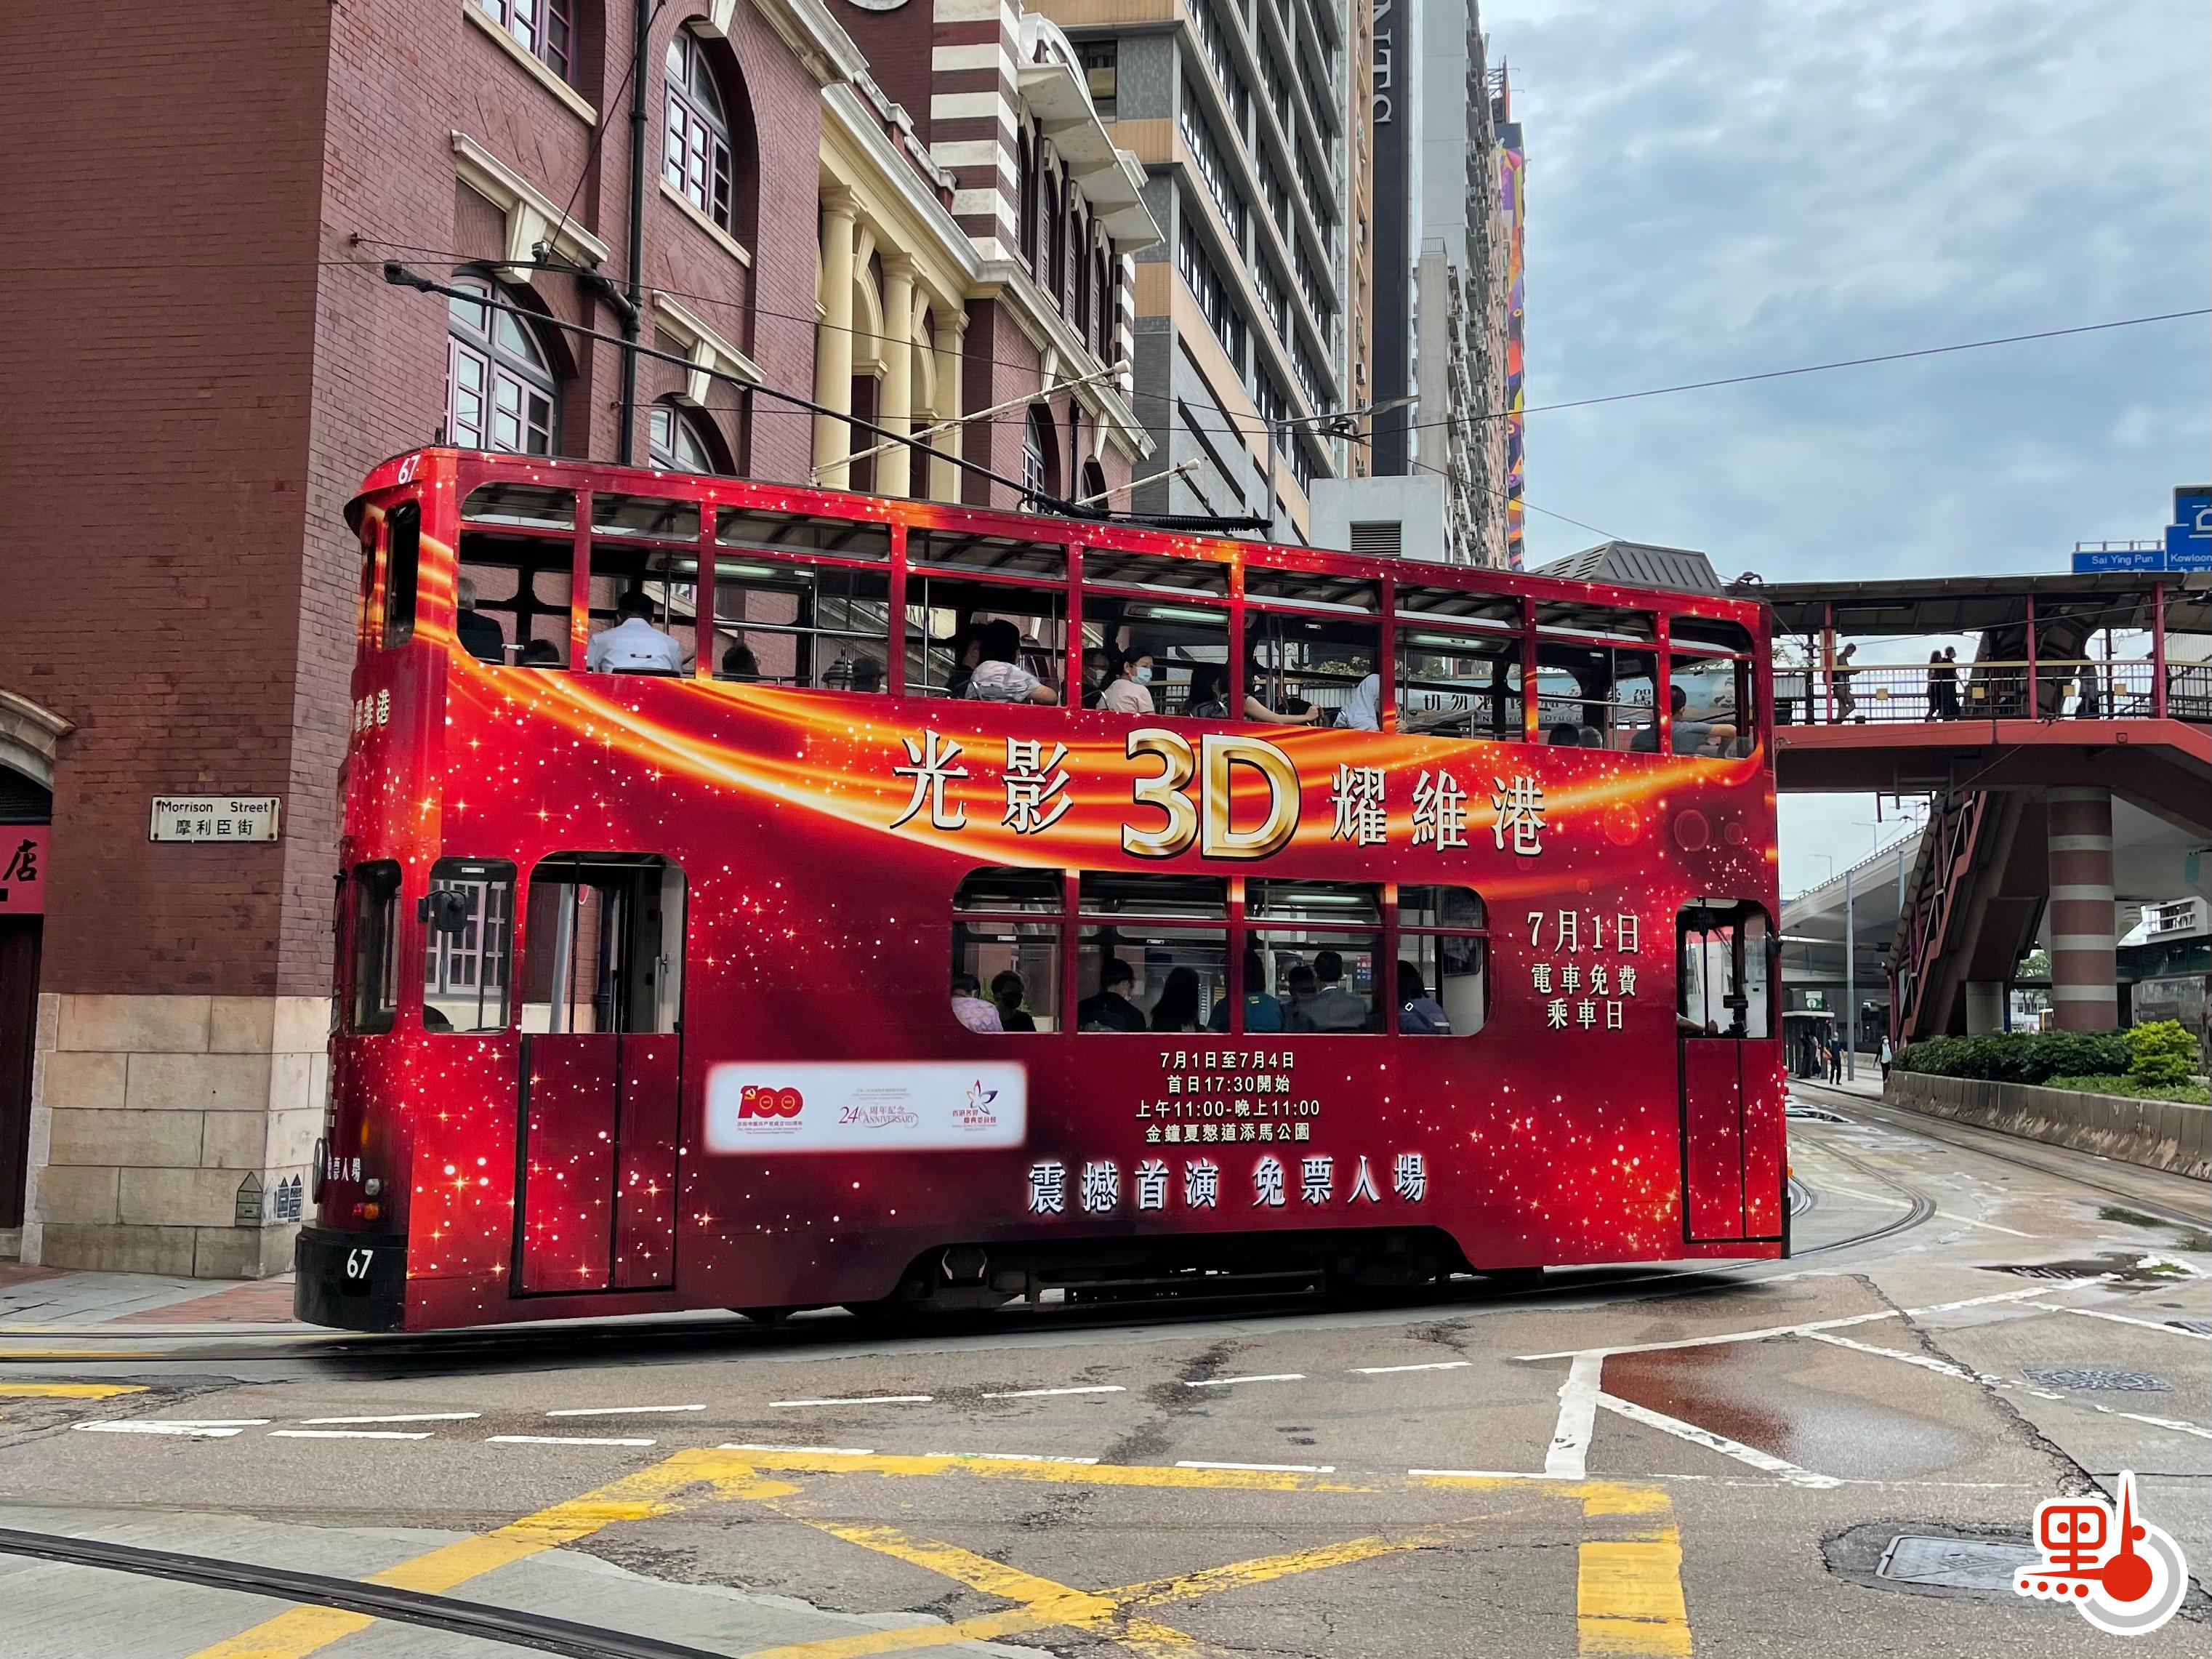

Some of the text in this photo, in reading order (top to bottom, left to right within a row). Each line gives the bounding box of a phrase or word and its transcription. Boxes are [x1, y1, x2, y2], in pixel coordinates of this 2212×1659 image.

[398, 454, 421, 485] 67
[2091, 554, 2153, 566] Sai Ying Pun
[2171, 553, 2212, 563] Kowloon
[161, 800, 268, 813] Morrison Street
[176, 819, 253, 836] 摩利臣街
[2, 839, 38, 882] 店
[1527, 909, 1640, 954] 7月1日
[1531, 963, 1637, 997] 電車免費
[1547, 997, 1623, 1030] 乘車日
[1160, 1051, 1294, 1069] 7月1日至7月4日
[1167, 1074, 1290, 1094] 首日17:30開始
[347, 1248, 374, 1279] 67
